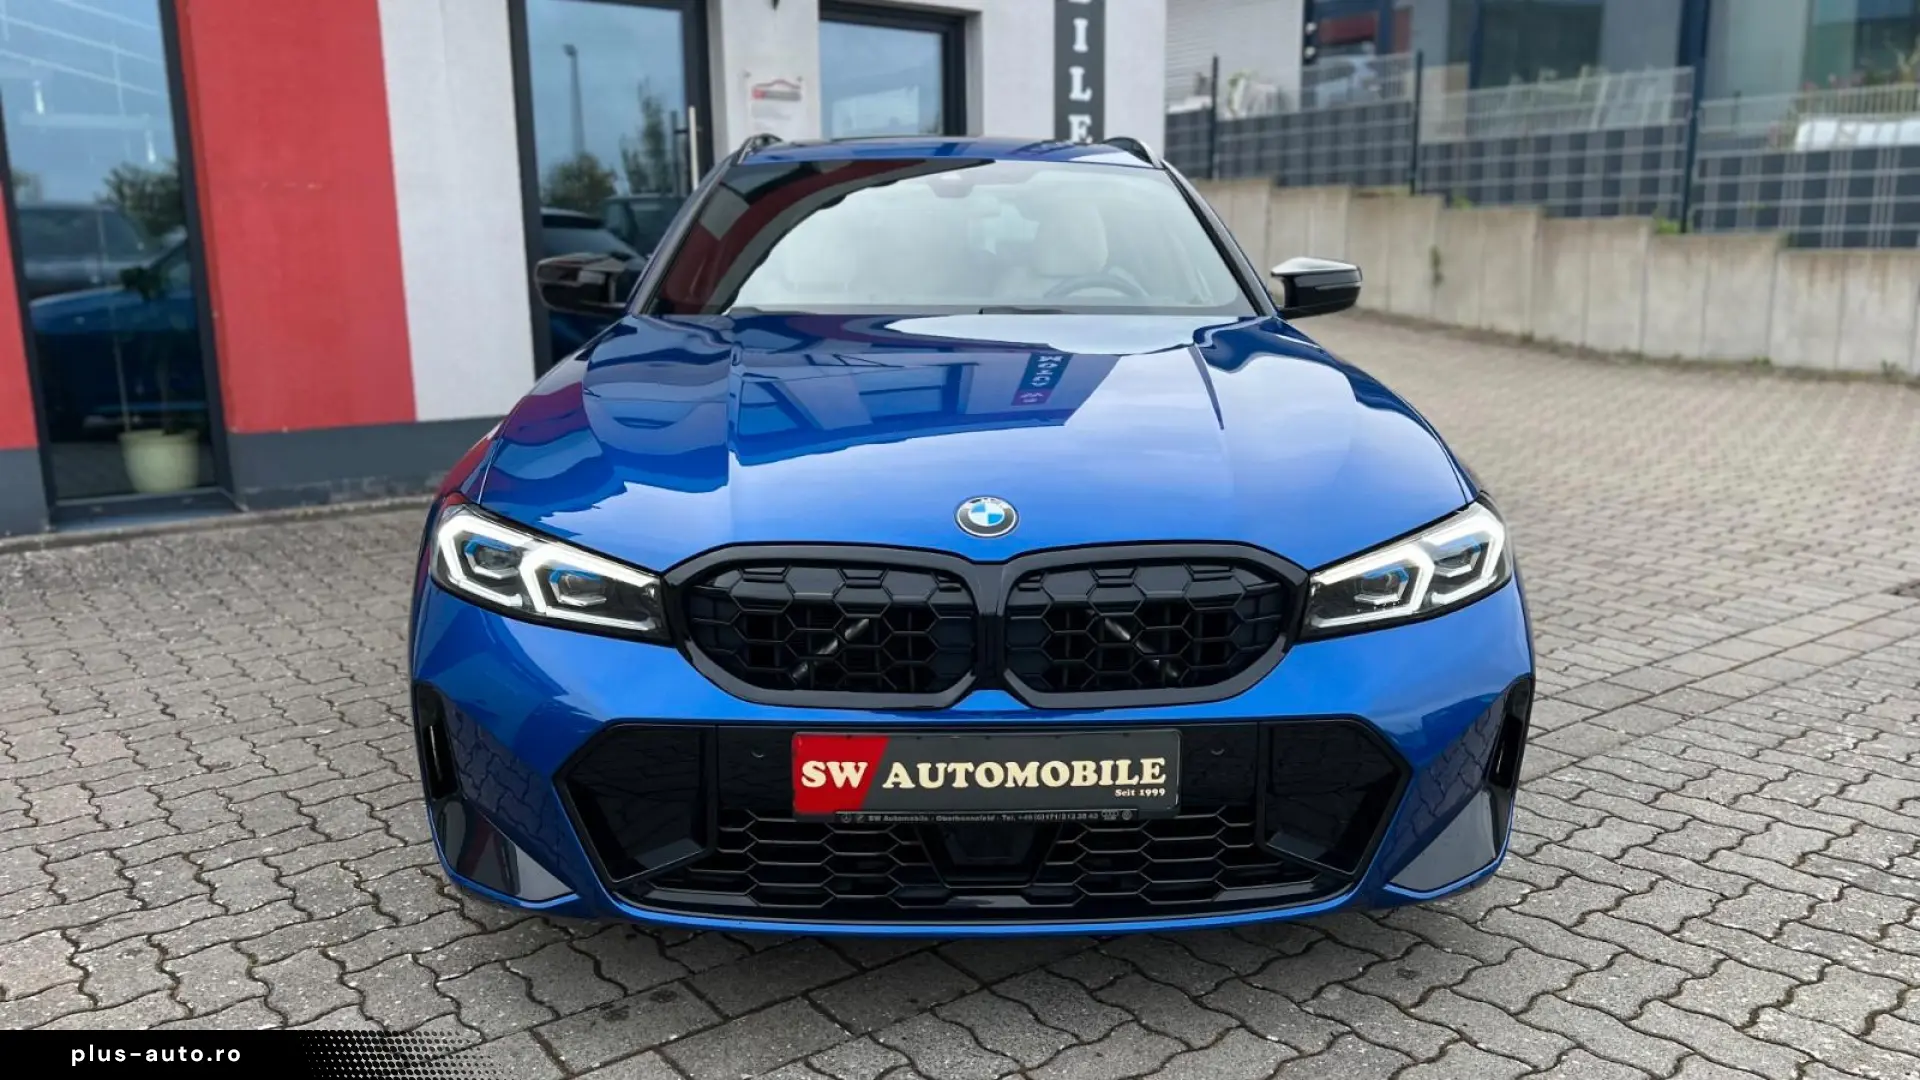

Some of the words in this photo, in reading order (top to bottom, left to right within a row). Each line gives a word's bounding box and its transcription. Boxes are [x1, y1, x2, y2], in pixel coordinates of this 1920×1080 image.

[1068, 0, 1092, 144] ILE
[801, 760, 868, 788] SW
[882, 757, 1166, 789] AUTOMOBILE
[1115, 788, 1135, 797] Seit
[1139, 788, 1165, 797] 1999
